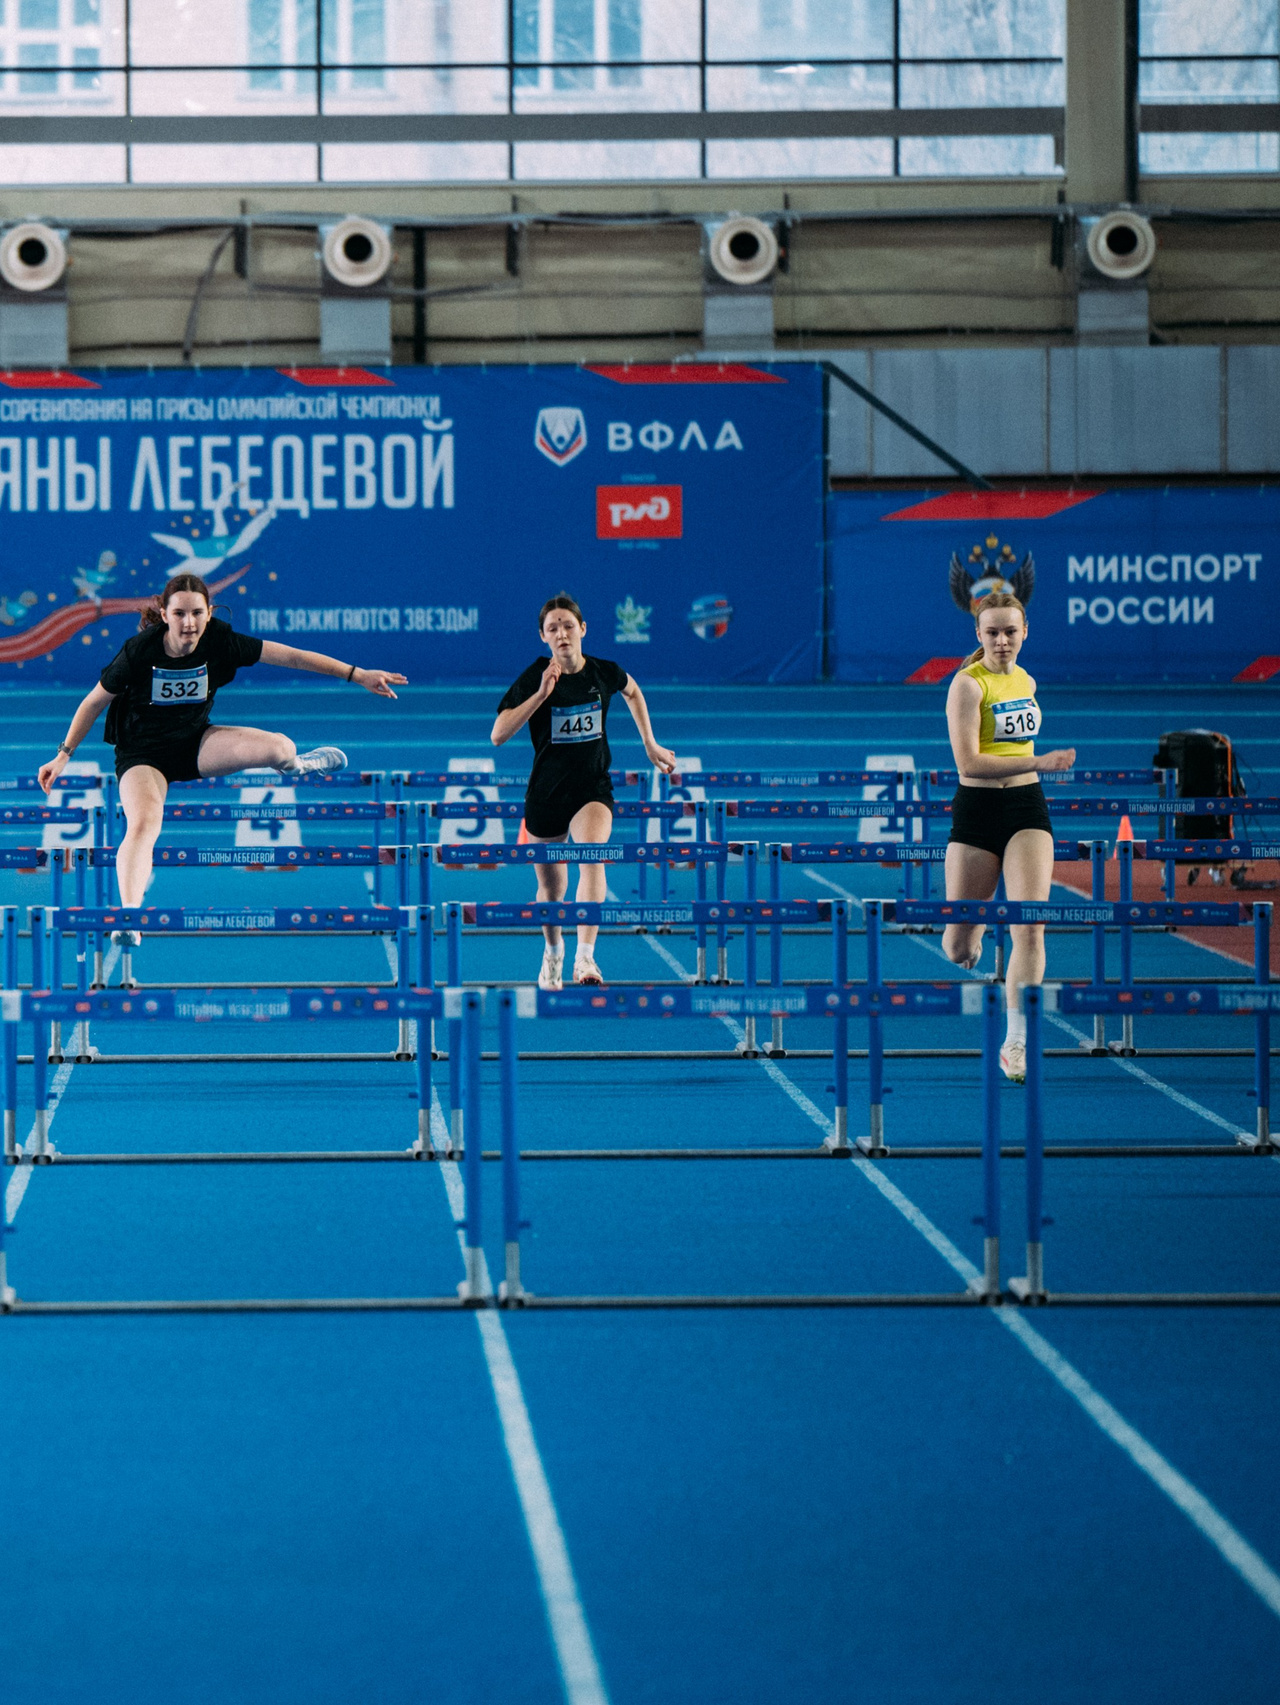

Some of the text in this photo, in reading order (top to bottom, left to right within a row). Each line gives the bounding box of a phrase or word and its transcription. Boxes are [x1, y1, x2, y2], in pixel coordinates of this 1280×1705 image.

[0, 397, 127, 421] СОРЕВНОВАНИЯ
[130, 397, 153, 421] НА
[156, 397, 213, 421] ПРИЗЫ
[217, 392, 338, 420] ОЛИМПИЙСКОЙ
[341, 395, 440, 419] ЧЕМПИОНКИ
[607, 420, 744, 451] ВФЛА
[130, 418, 456, 519] ЛЕБЕДЕВОЙ
[1067, 553, 1263, 582] МИНСПОРТ
[1067, 597, 1215, 624] РОССИИ
[249, 607, 479, 633] ТАК ЗАЖИГАЮТСЯ ЗВЕЗДЫ!
[160, 681, 199, 698] 532
[560, 715, 594, 735] 443
[1004, 712, 1036, 734] 518
[198, 852, 231, 863] ТАТЬЯНЫ
[547, 850, 580, 861] ТАТЬЯНЫ
[896, 849, 930, 860] ТАТЬЯНЫ
[1251, 847, 1280, 858] ТАТЬЯН
[183, 916, 223, 928] ТАТЬЯНЫ
[601, 910, 640, 923] ТАТЬЯНЫ
[1021, 908, 1061, 921] ТАТЬЯНЫ
